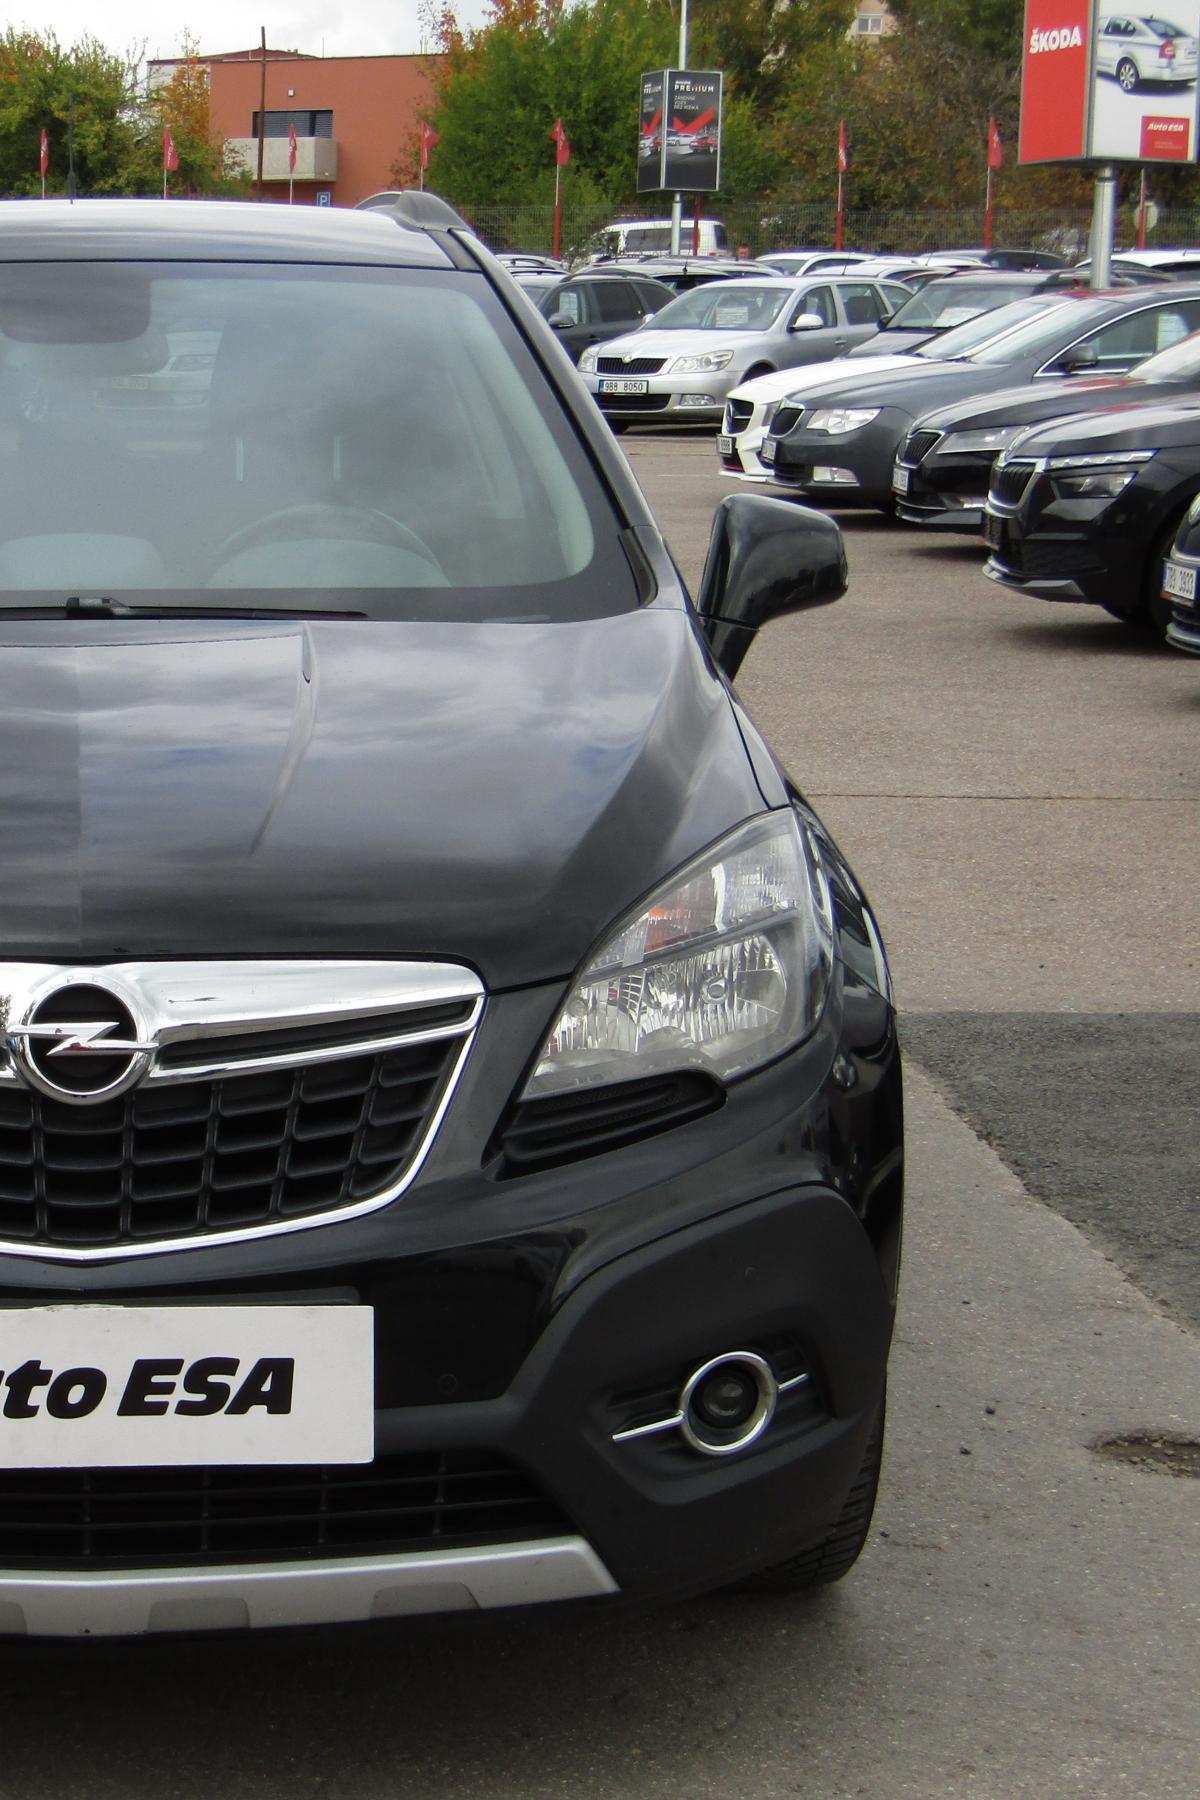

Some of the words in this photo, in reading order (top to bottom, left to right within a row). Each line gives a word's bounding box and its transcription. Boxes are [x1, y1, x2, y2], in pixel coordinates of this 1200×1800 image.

[1029, 25, 1082, 54] ŠKODA
[623, 382, 644, 392] 8050
[116, 1356, 296, 1417] ESA
